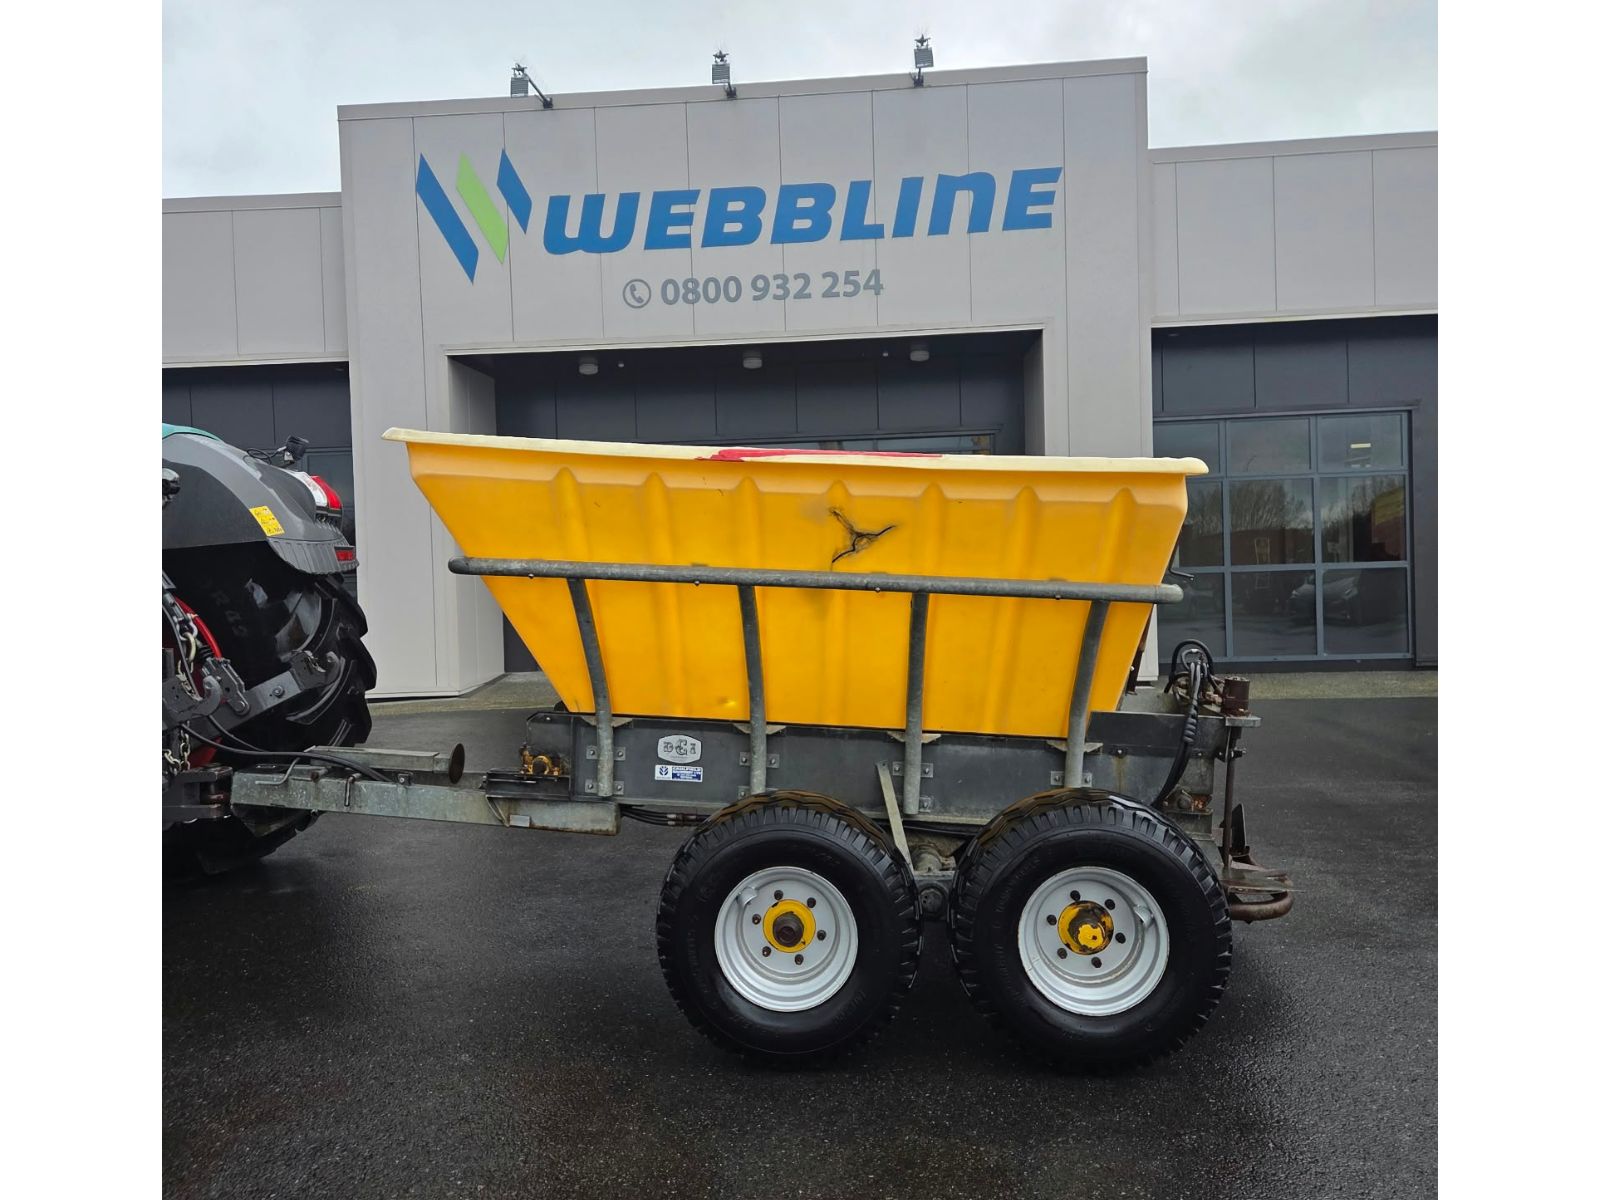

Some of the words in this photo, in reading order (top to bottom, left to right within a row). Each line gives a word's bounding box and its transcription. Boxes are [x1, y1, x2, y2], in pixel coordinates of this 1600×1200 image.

[543, 168, 1062, 254] WEBBLINE
[660, 276, 743, 306] 0800
[750, 273, 812, 301] 932
[821, 268, 885, 298] 254
